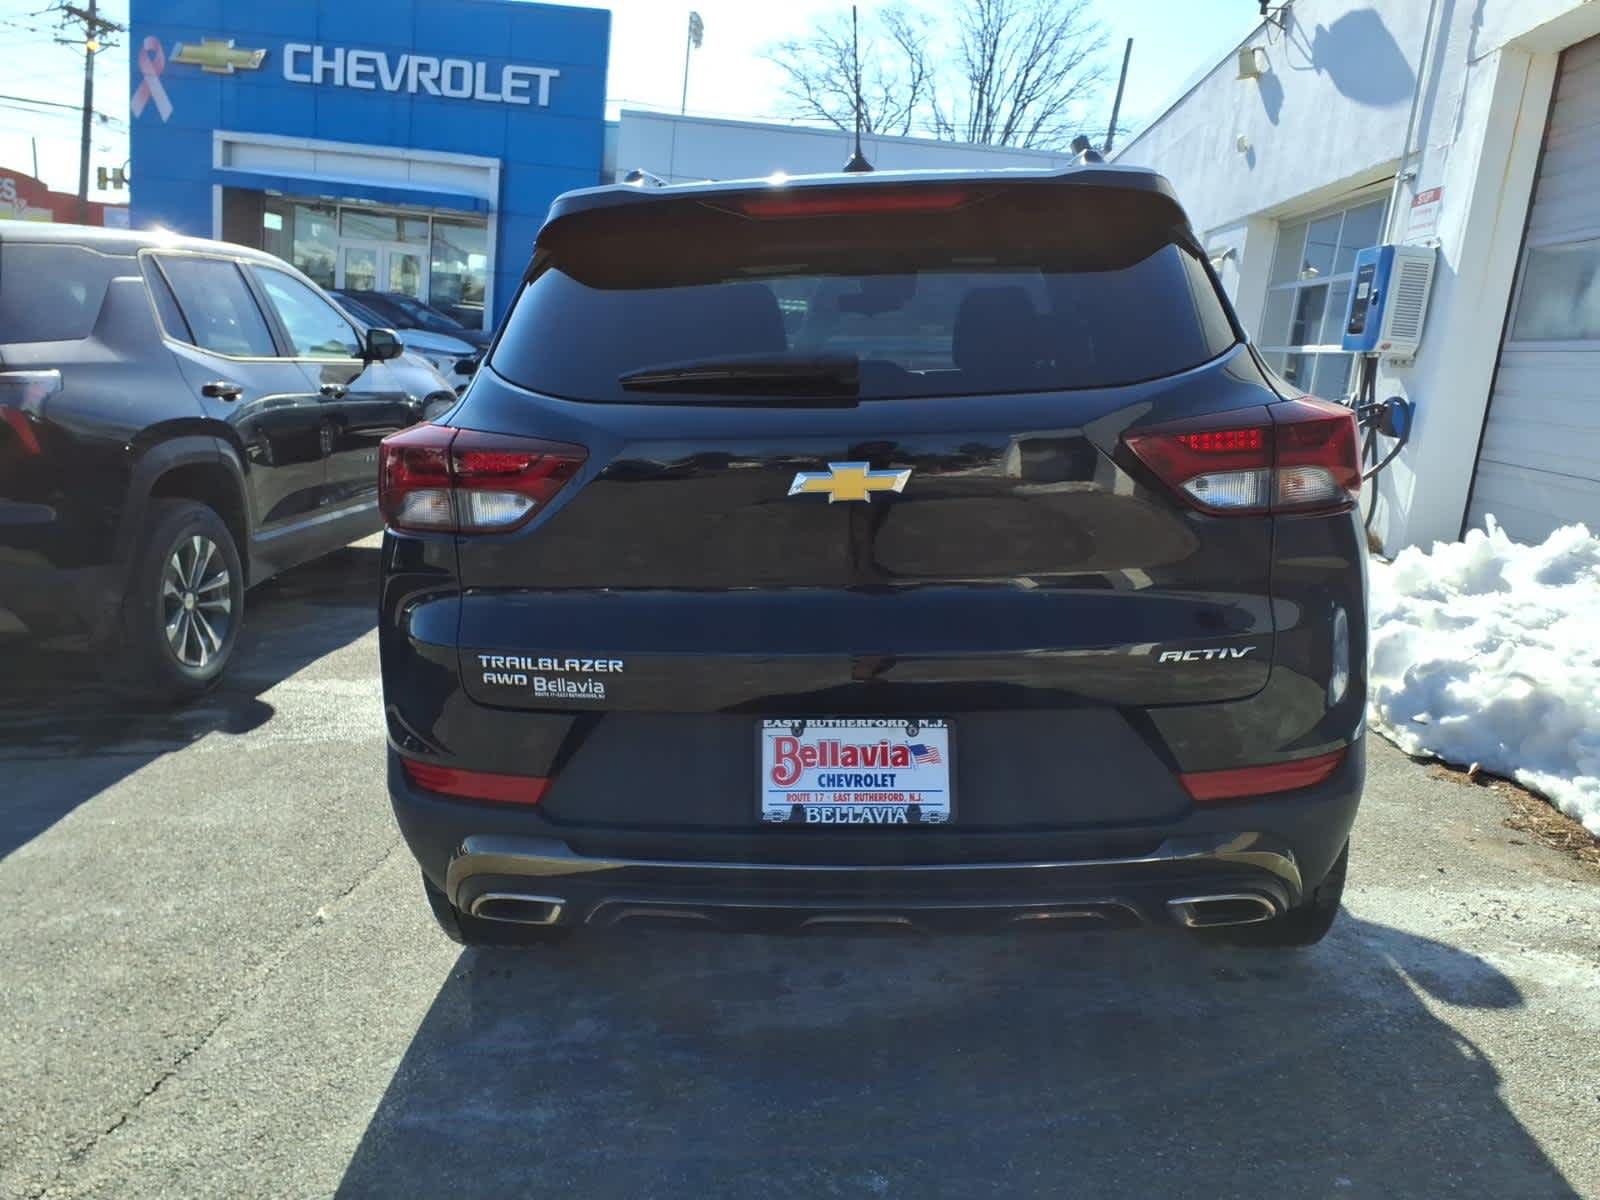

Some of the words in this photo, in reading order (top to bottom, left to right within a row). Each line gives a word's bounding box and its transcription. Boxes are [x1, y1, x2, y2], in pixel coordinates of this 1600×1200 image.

[283, 43, 560, 106] CHEVROLET
[1159, 647, 1257, 663] ACTIV
[478, 655, 624, 673] TRAILBLAZER
[483, 672, 528, 686] AWD
[533, 676, 605, 694] Bellavia
[763, 719, 802, 728] EAST
[919, 719, 948, 728] N.J.
[771, 736, 911, 787] Bellavia
[818, 773, 896, 788] CHEVROLET
[786, 793, 811, 802] ROUTE
[815, 793, 825, 802] 17
[833, 793, 851, 802] EAST
[805, 806, 909, 824] BELLAVIA
